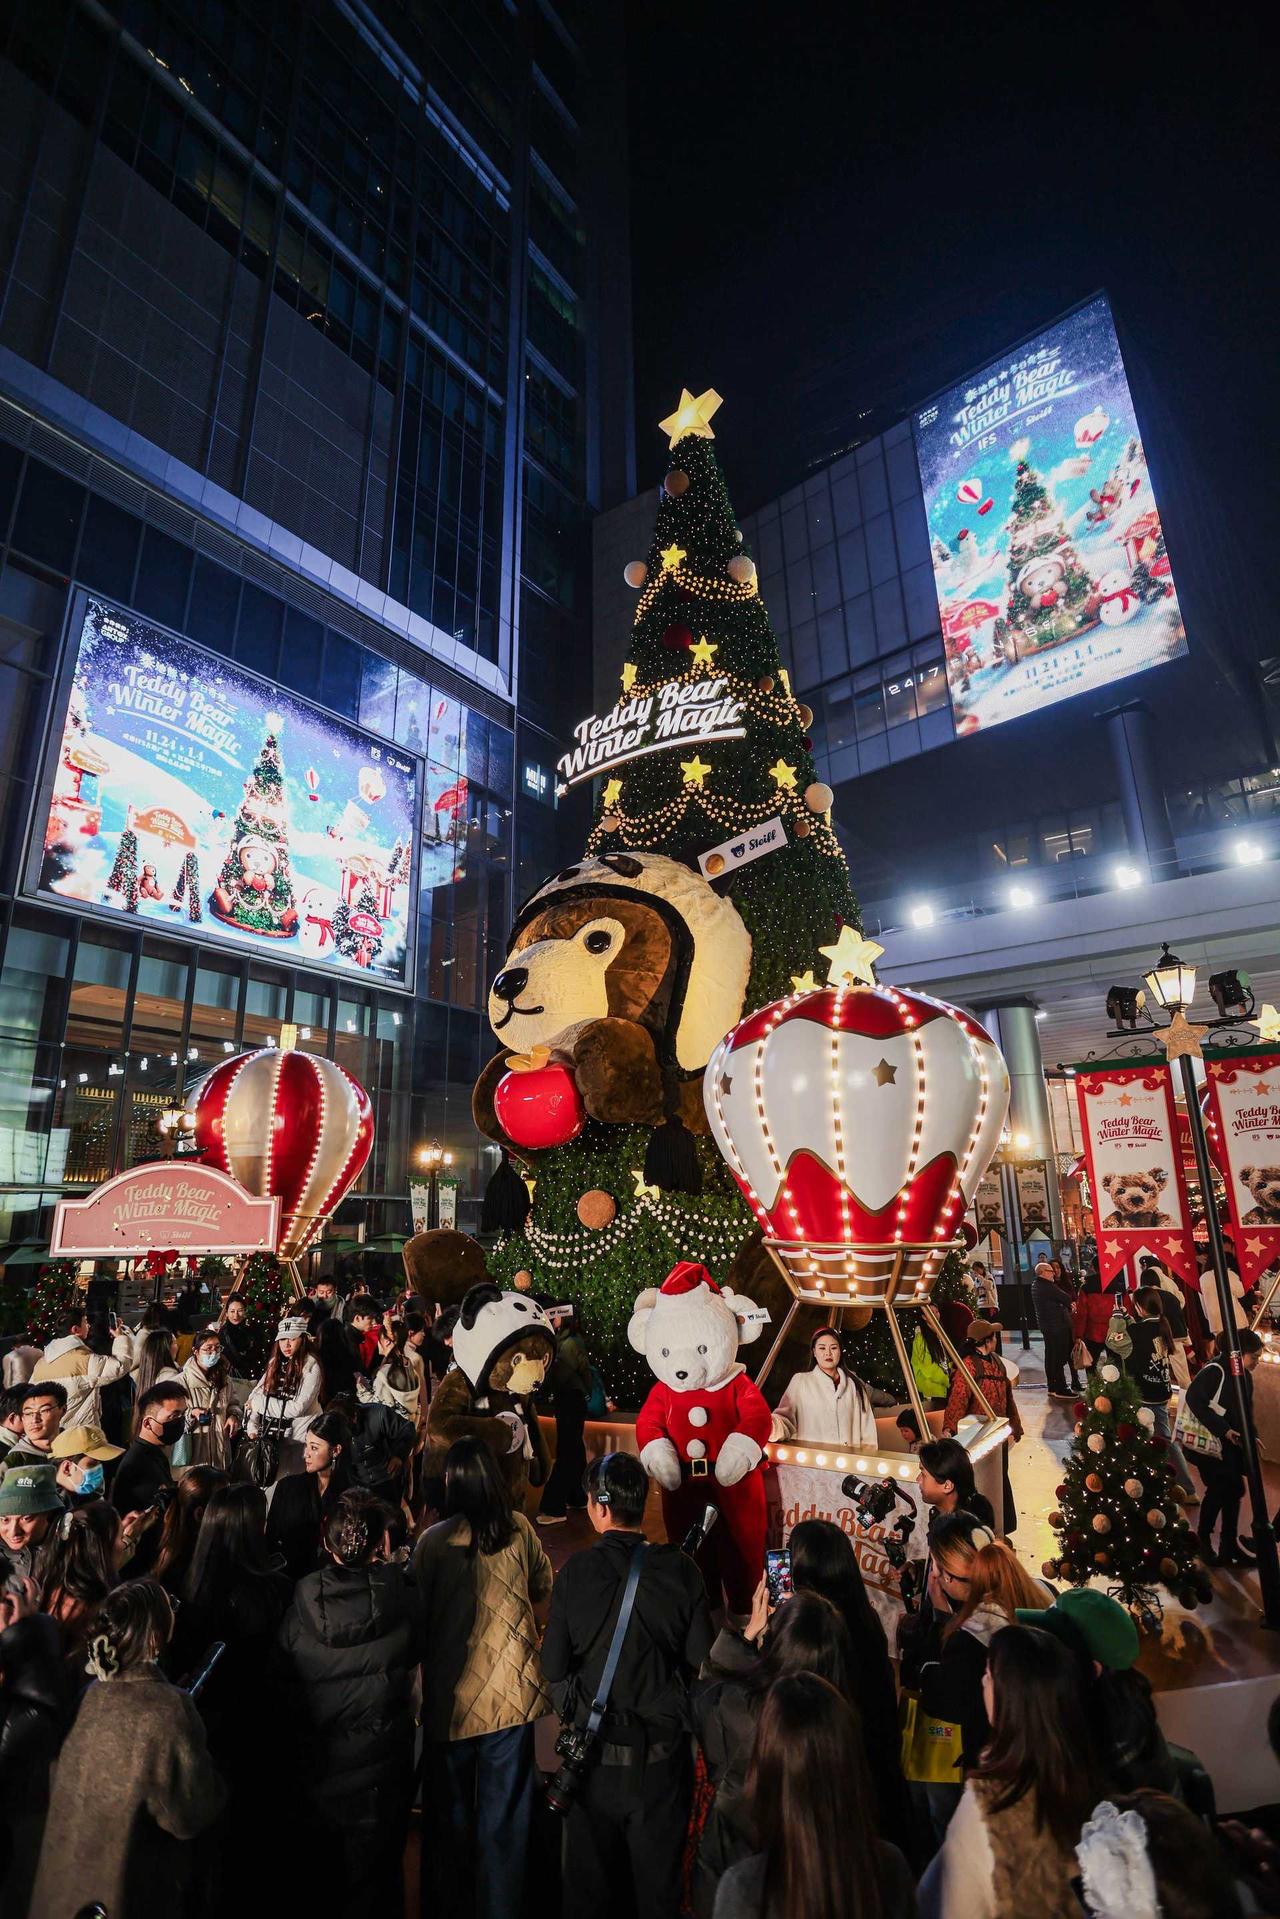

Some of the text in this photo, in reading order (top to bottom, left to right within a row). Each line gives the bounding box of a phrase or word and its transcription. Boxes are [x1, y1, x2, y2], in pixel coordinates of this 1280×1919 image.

[952, 383, 1010, 425] Teddy
[1013, 359, 1061, 390] Bear
[951, 401, 1011, 446] Winter
[1015, 369, 1076, 409] Magic
[978, 432, 997, 451] IFS
[124, 666, 187, 708] Teddy
[190, 690, 235, 728] Bear
[108, 683, 183, 721] Winter
[185, 710, 241, 755] Magic
[574, 677, 729, 746] Teddy Bear
[557, 696, 747, 778] Winter Magic
[749, 829, 776, 850] Steiff
[1100, 1115, 1155, 1129] Teddy Bear
[1236, 1106, 1268, 1119] Teddy
[1096, 1125, 1163, 1139] Winter Magic
[1231, 1117, 1269, 1130] Winter
[124, 1182, 215, 1202] Teddy Bear
[113, 1199, 222, 1223] Winter Magic
[284, 1322, 291, 1331] W
